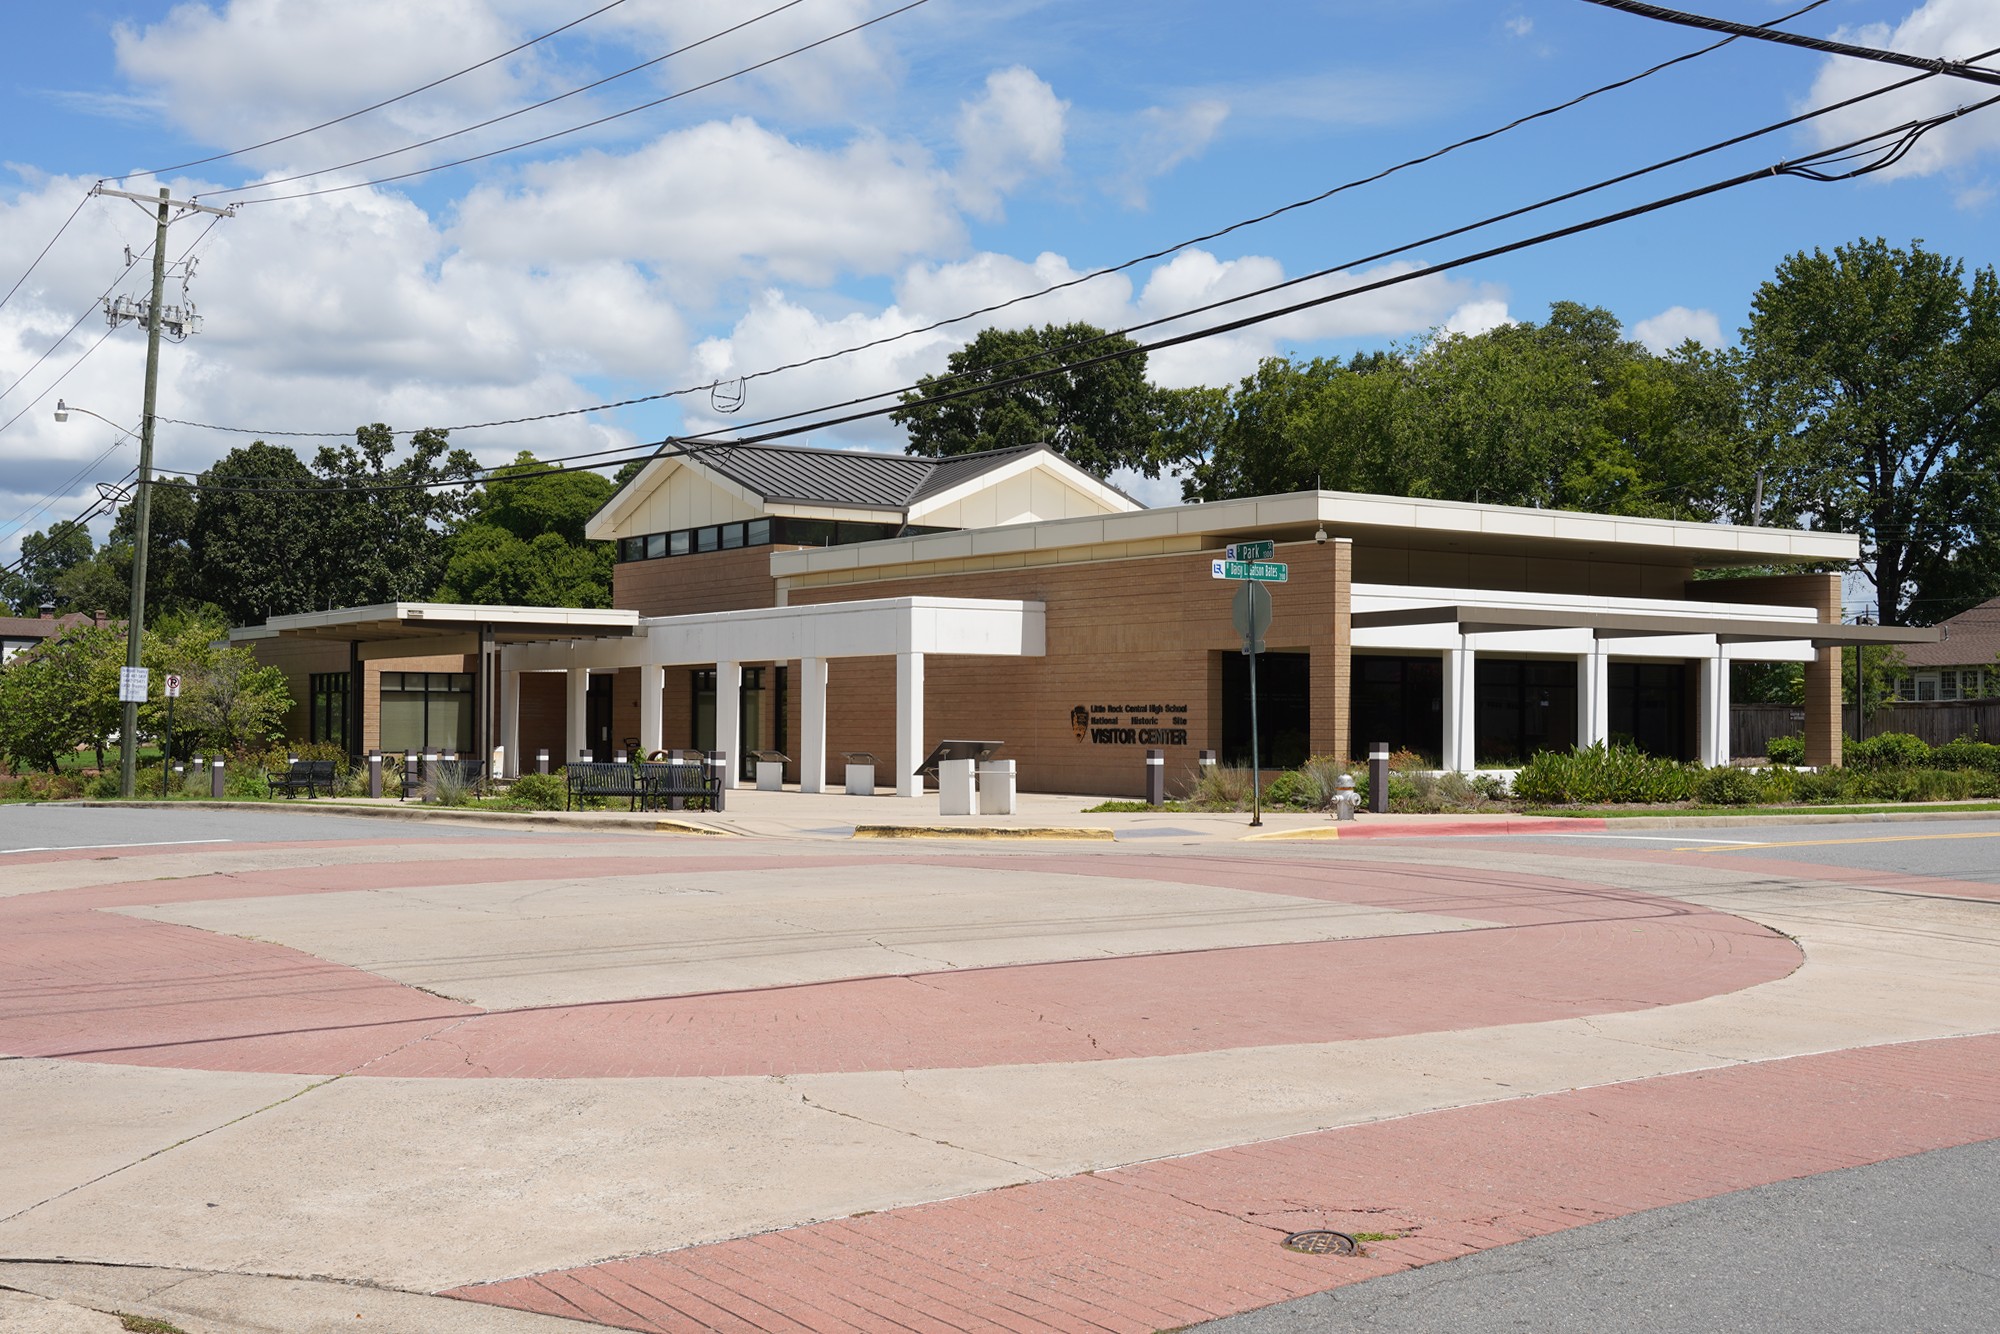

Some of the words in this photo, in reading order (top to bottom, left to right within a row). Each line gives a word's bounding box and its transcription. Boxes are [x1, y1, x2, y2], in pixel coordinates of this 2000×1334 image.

[1243, 544, 1260, 559] Park
[1231, 562, 1243, 578] Daisy
[1265, 565, 1278, 576] Bates
[1149, 704, 1163, 714] High
[1165, 704, 1187, 712] School
[1091, 728, 1136, 744] VISITOR
[1138, 729, 1187, 745] CENTER
